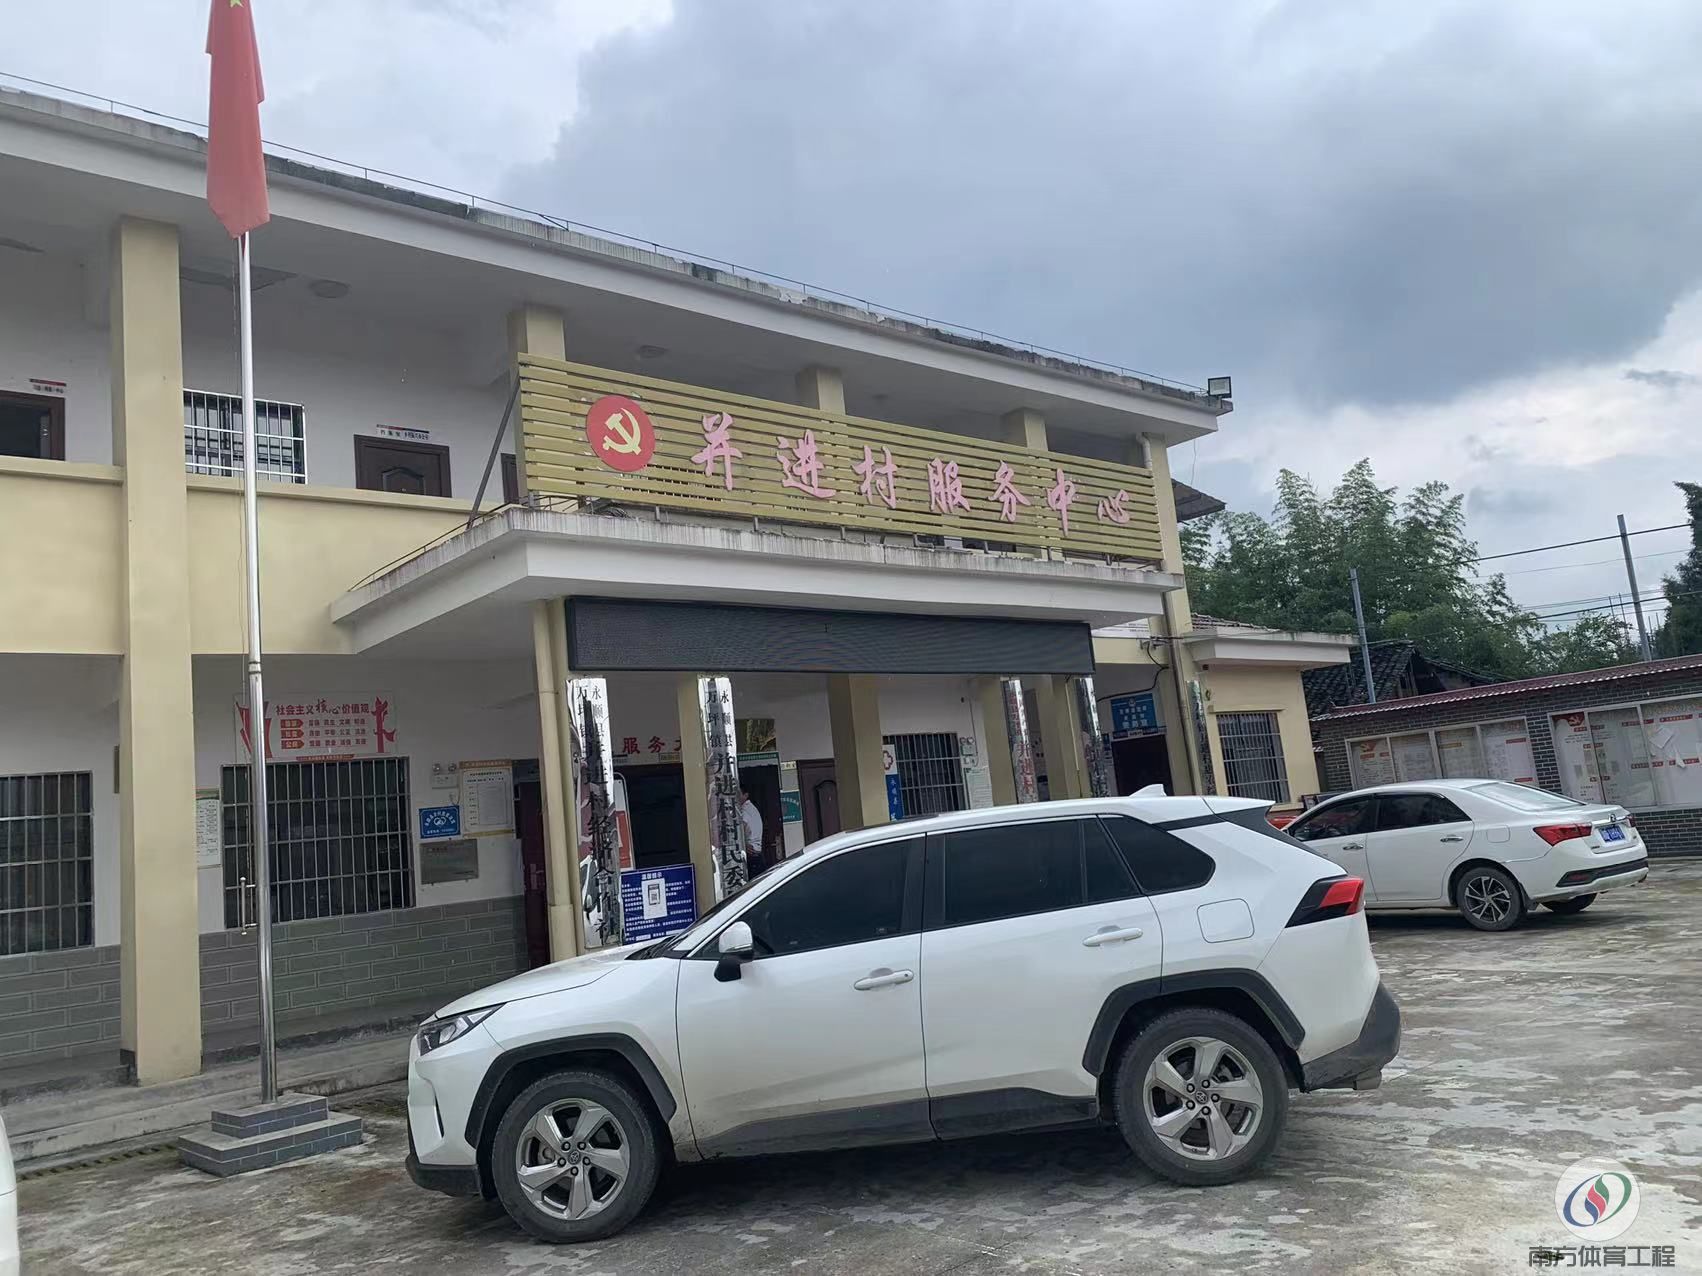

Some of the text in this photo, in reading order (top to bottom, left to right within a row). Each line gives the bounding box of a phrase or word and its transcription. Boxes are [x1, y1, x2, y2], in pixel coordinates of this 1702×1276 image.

[691, 411, 1132, 536] 并进村服务中心
[276, 699, 370, 716] 社会主义核心价值观
